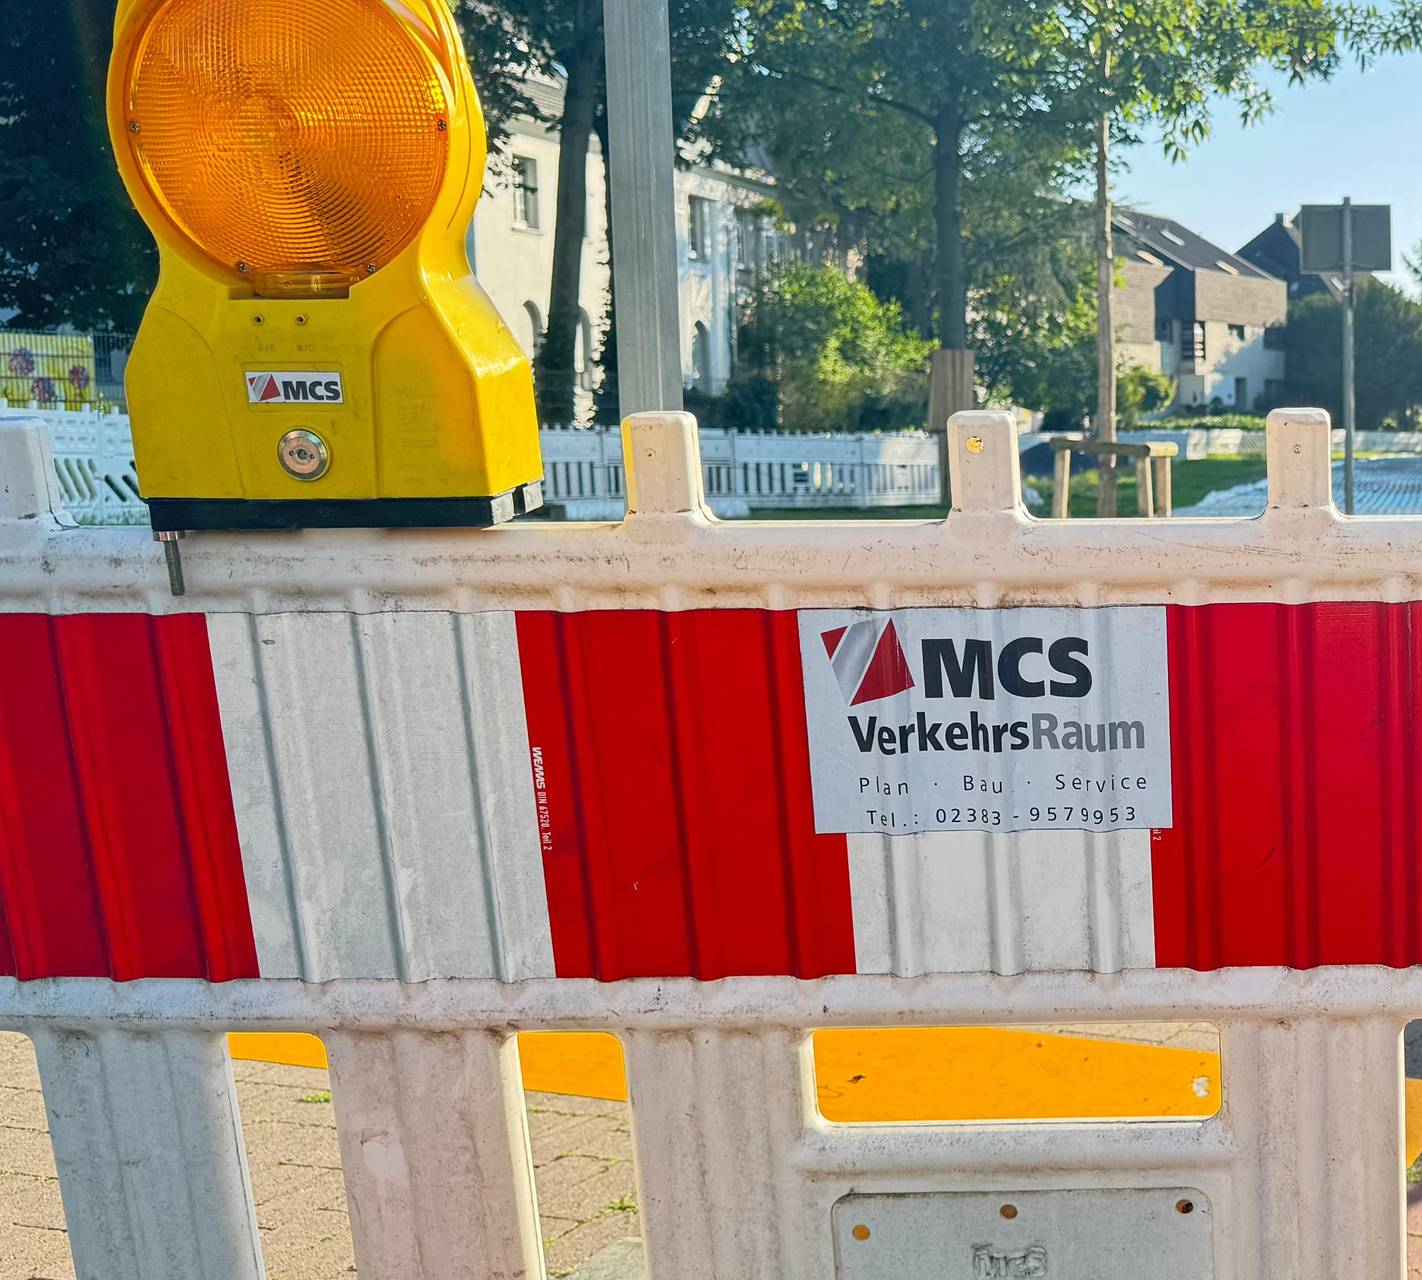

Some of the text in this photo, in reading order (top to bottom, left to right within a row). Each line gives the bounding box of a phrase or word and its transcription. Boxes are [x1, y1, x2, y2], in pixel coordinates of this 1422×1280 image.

[282, 381, 341, 401] MCS
[921, 637, 1093, 700] MCS
[847, 711, 1145, 755] VerkehrsRaum
[860, 776, 909, 795] Plan
[964, 776, 1002, 794] Bau
[1056, 774, 1146, 792] Service
[538, 792, 548, 804] DIN
[867, 810, 917, 828] Tel.:
[542, 832, 552, 844] Teil
